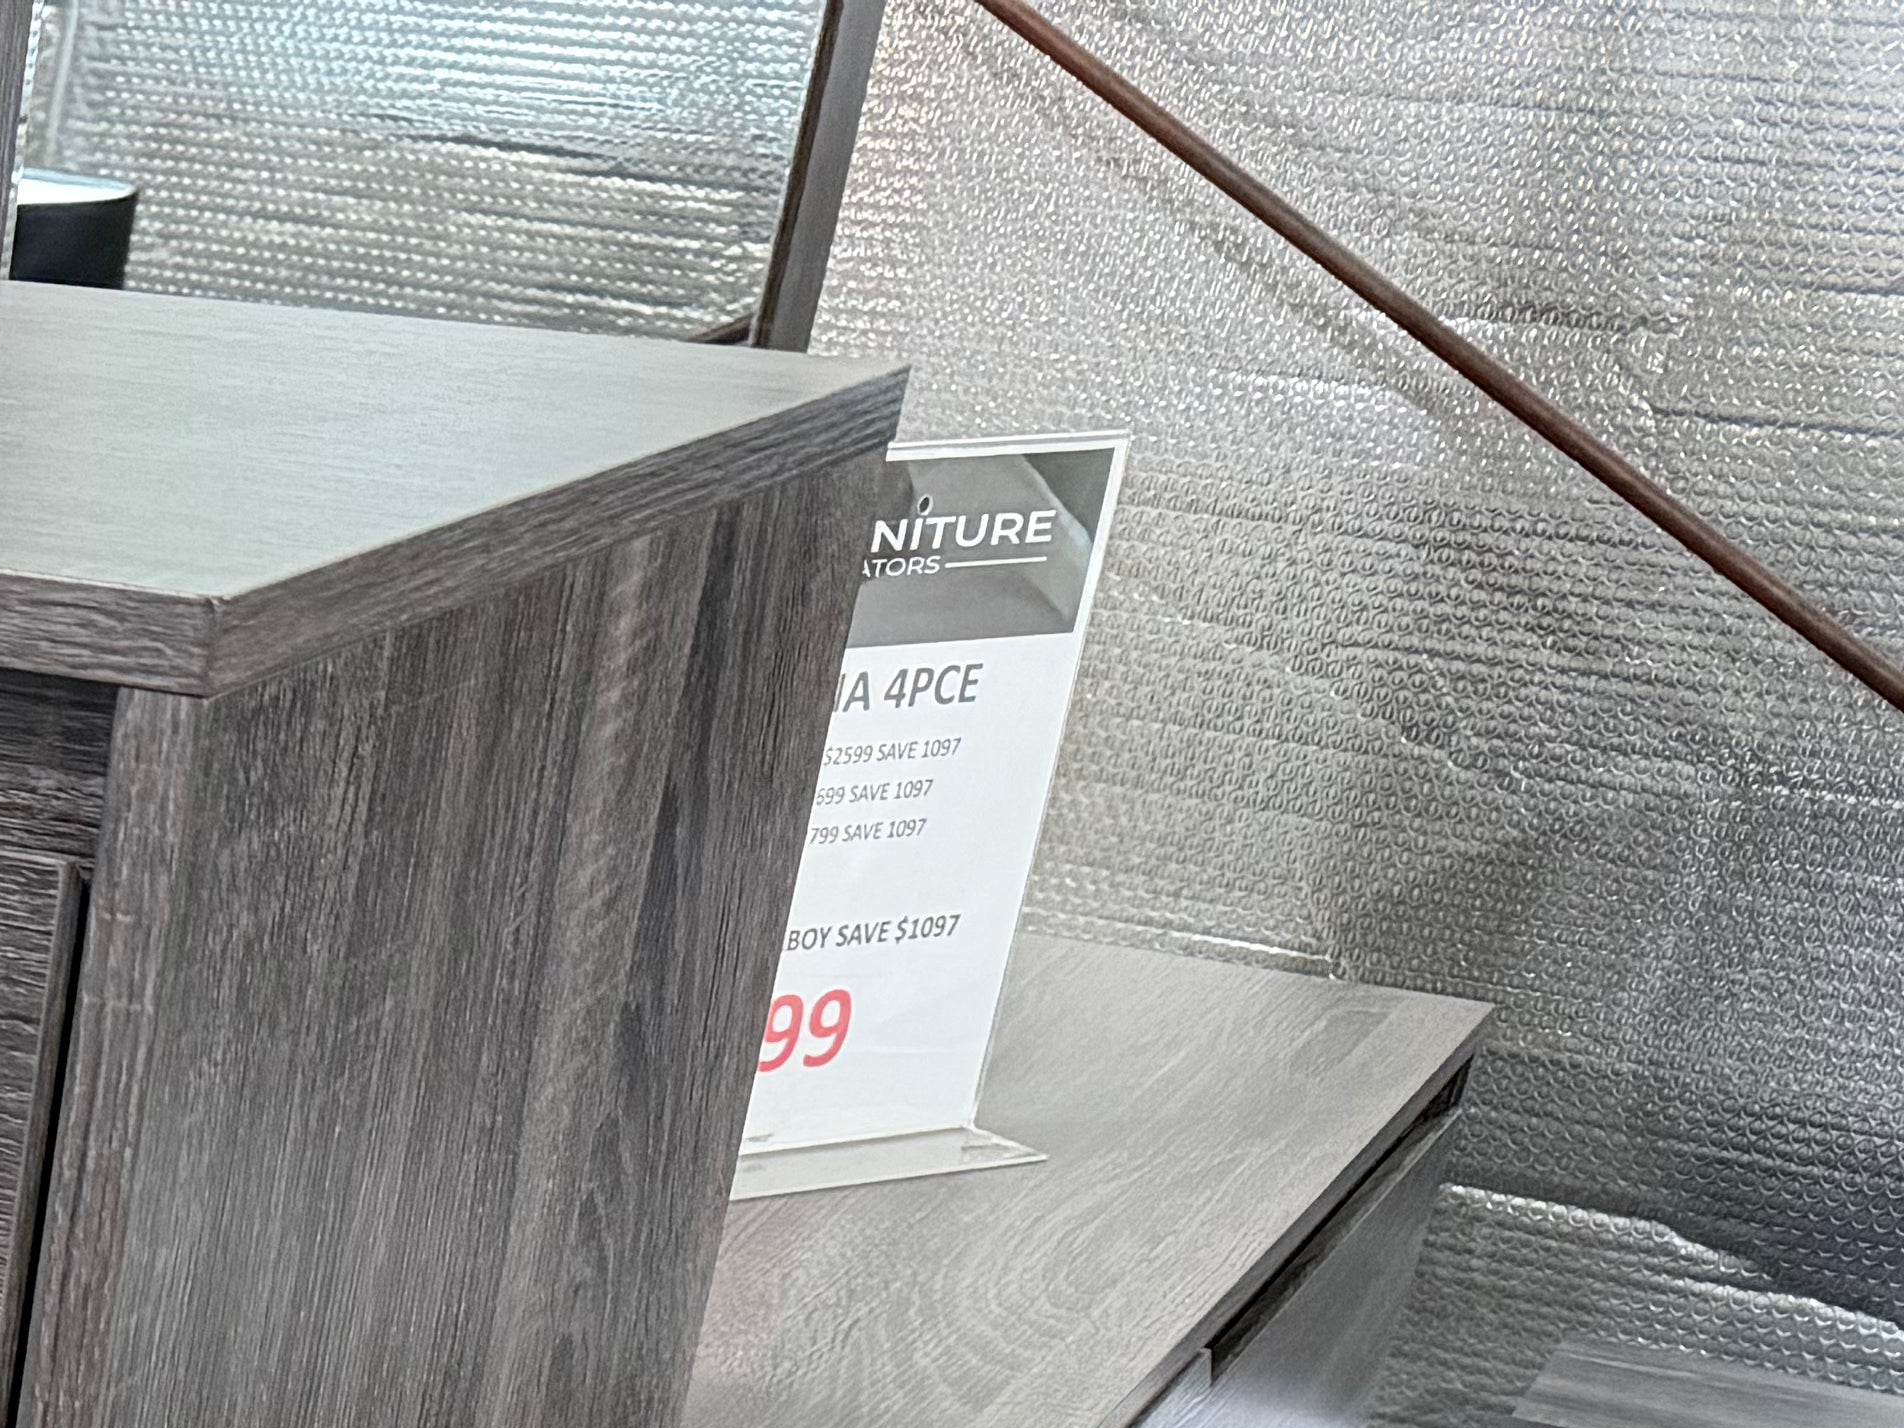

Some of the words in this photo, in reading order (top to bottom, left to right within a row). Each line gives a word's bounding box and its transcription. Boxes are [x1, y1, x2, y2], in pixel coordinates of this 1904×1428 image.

[883, 663, 984, 709] 4PCE
[876, 740, 919, 762] SAVE
[921, 737, 962, 759] 1097
[849, 783, 890, 803] SAVE
[893, 779, 934, 799] 1097
[809, 826, 839, 845] 799
[842, 822, 884, 842] SAVE
[887, 818, 927, 839] 1097
[785, 926, 832, 951] BOY
[835, 920, 892, 947] SAVE
[894, 914, 961, 944] $1097
